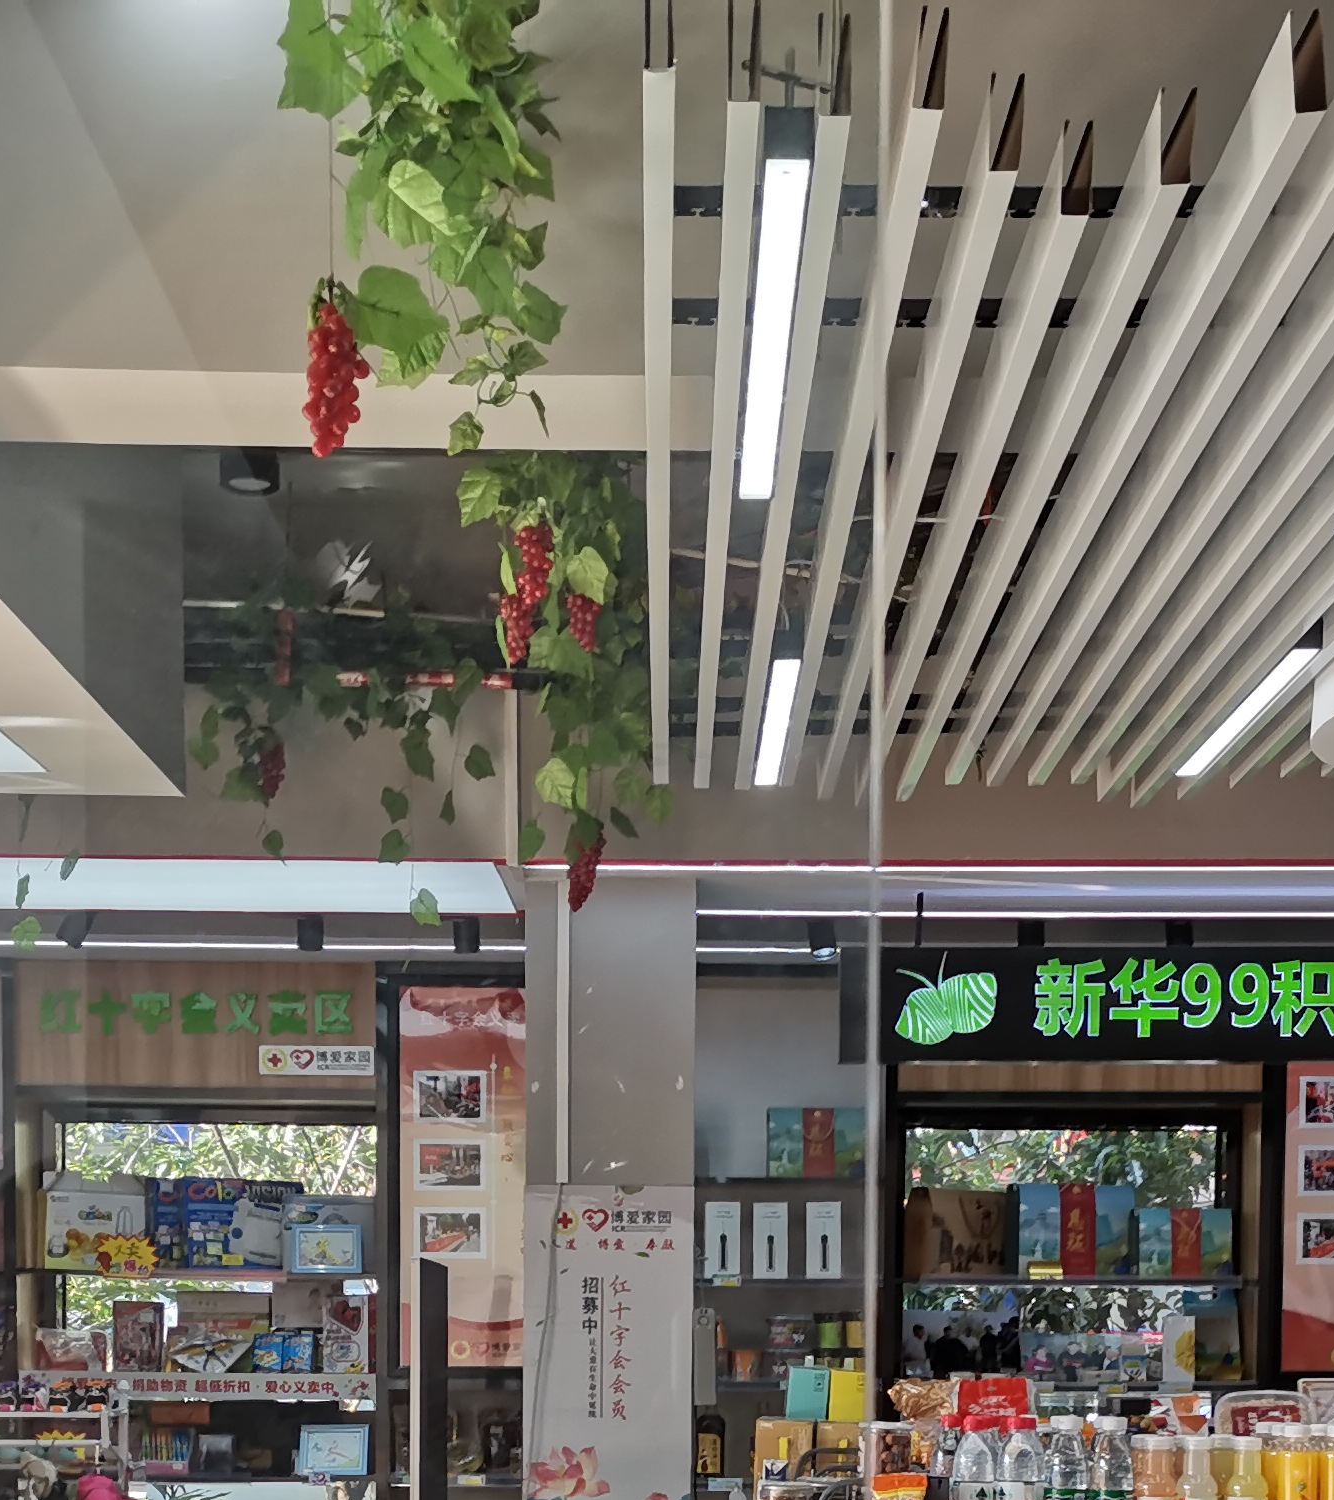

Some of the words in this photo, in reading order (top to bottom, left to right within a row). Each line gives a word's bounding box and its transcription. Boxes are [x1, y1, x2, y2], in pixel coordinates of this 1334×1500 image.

[610, 1210, 672, 1225] 博爱家园
[581, 1276, 599, 1335] 招募中
[608, 1274, 632, 1421] 红十字会会员
[195, 1379, 250, 1394] 超低折扣
[265, 1380, 335, 1395] 爱心义卖中
